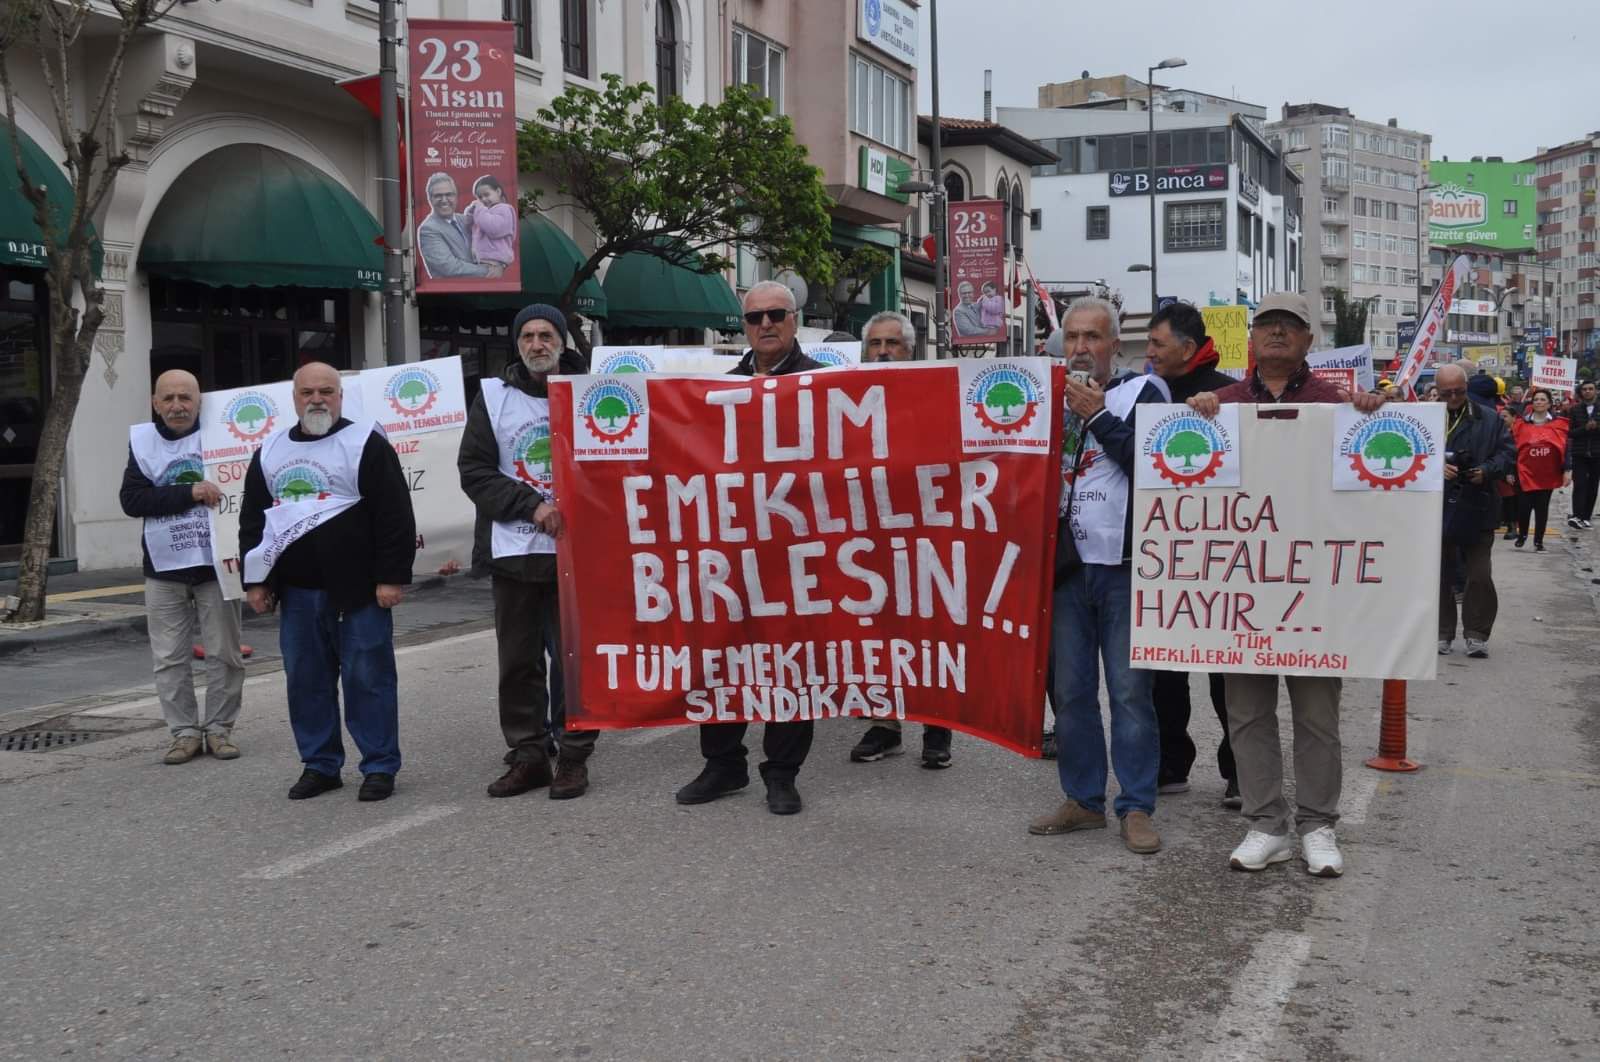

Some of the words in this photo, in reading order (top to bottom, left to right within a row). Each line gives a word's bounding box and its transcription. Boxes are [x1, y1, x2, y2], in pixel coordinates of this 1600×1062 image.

[418, 37, 482, 82] 23
[420, 83, 504, 108] Nisan
[954, 211, 987, 234] 23
[955, 235, 998, 248] Nisan
[1465, 231, 1497, 242] güven
[1541, 367, 1566, 377] YETER!
[705, 374, 889, 464] TÜM
[1529, 448, 1551, 457] CHP
[622, 460, 998, 544] EMEKLİLER
[1142, 492, 1279, 533] AÇLIĞA
[1136, 589, 1263, 632] HAYIR
[1233, 632, 1273, 650] TÜM
[596, 643, 692, 692] TÜM
[702, 638, 966, 694] EMEKLİLERİN
[1131, 644, 1243, 665] EMEKLİLERİN
[1254, 649, 1348, 670] SENDİKASI
[685, 683, 906, 722] SENDİKASI
